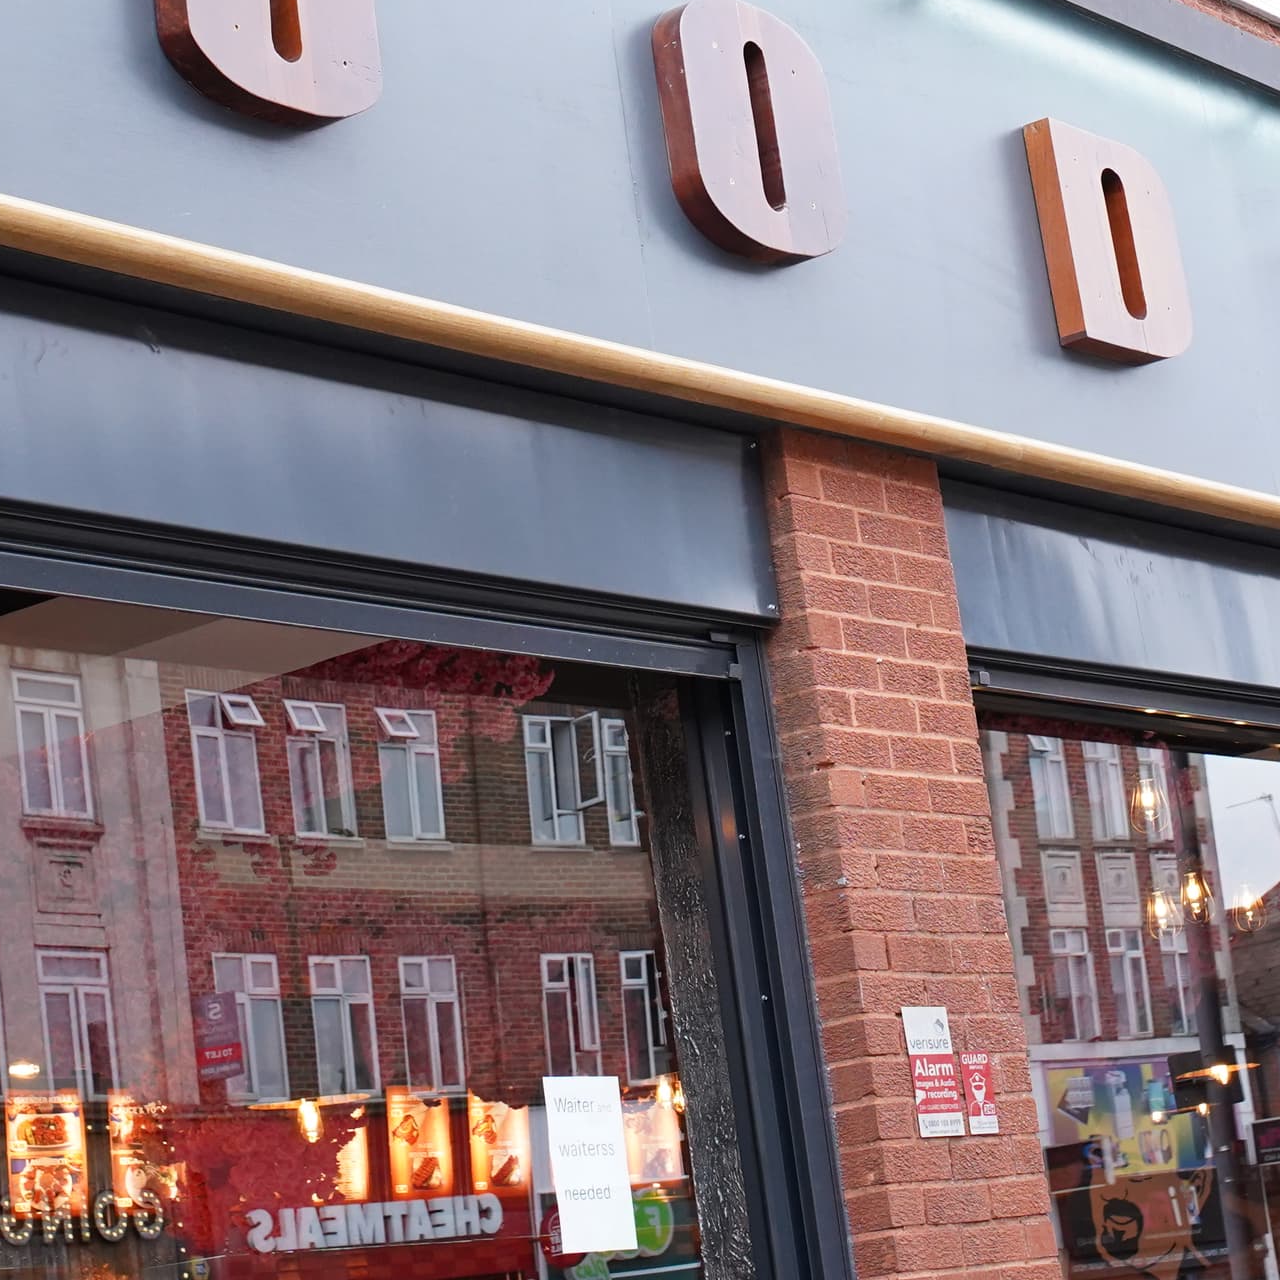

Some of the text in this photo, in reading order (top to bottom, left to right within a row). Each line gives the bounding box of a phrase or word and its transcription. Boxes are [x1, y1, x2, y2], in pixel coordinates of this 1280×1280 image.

[909, 1038, 949, 1049] verisure
[914, 1058, 954, 1076] Alarm
[961, 1054, 988, 1065] GUARD
[553, 1097, 595, 1113] Waiter
[558, 1140, 615, 1157] waiterss
[564, 1185, 611, 1200] needed
